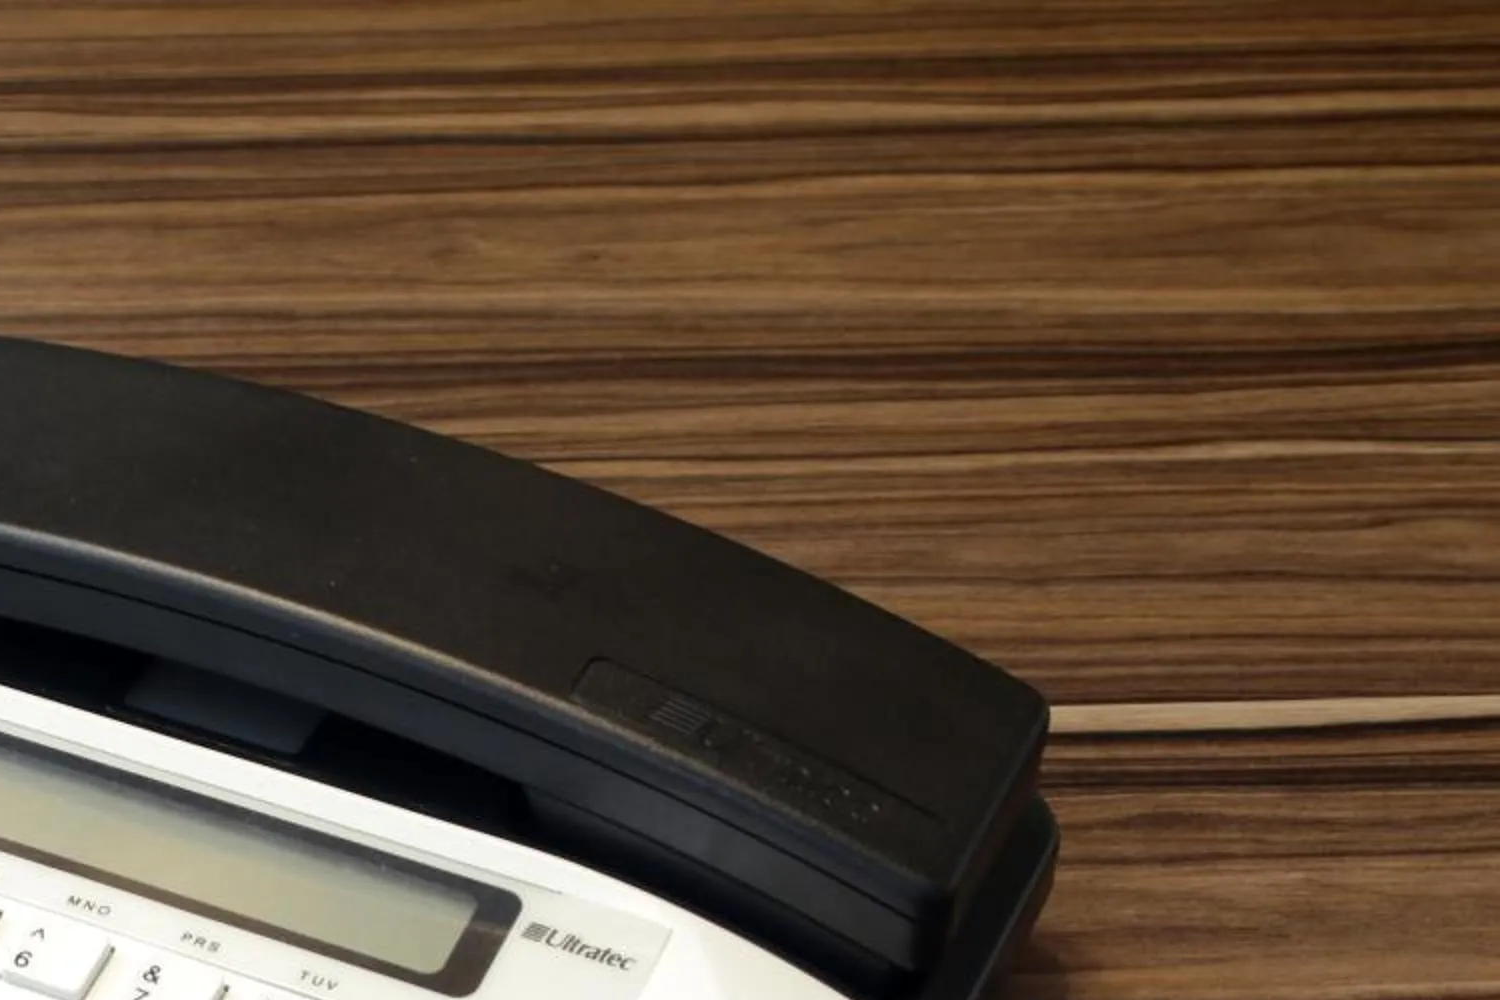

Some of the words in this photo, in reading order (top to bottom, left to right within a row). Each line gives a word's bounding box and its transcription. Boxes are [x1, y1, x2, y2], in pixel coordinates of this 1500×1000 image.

[67, 895, 111, 916] MNO
[180, 931, 221, 953] PRS
[544, 927, 638, 972] Ultratec
[13, 950, 33, 968] 6
[299, 968, 341, 991] TUV
